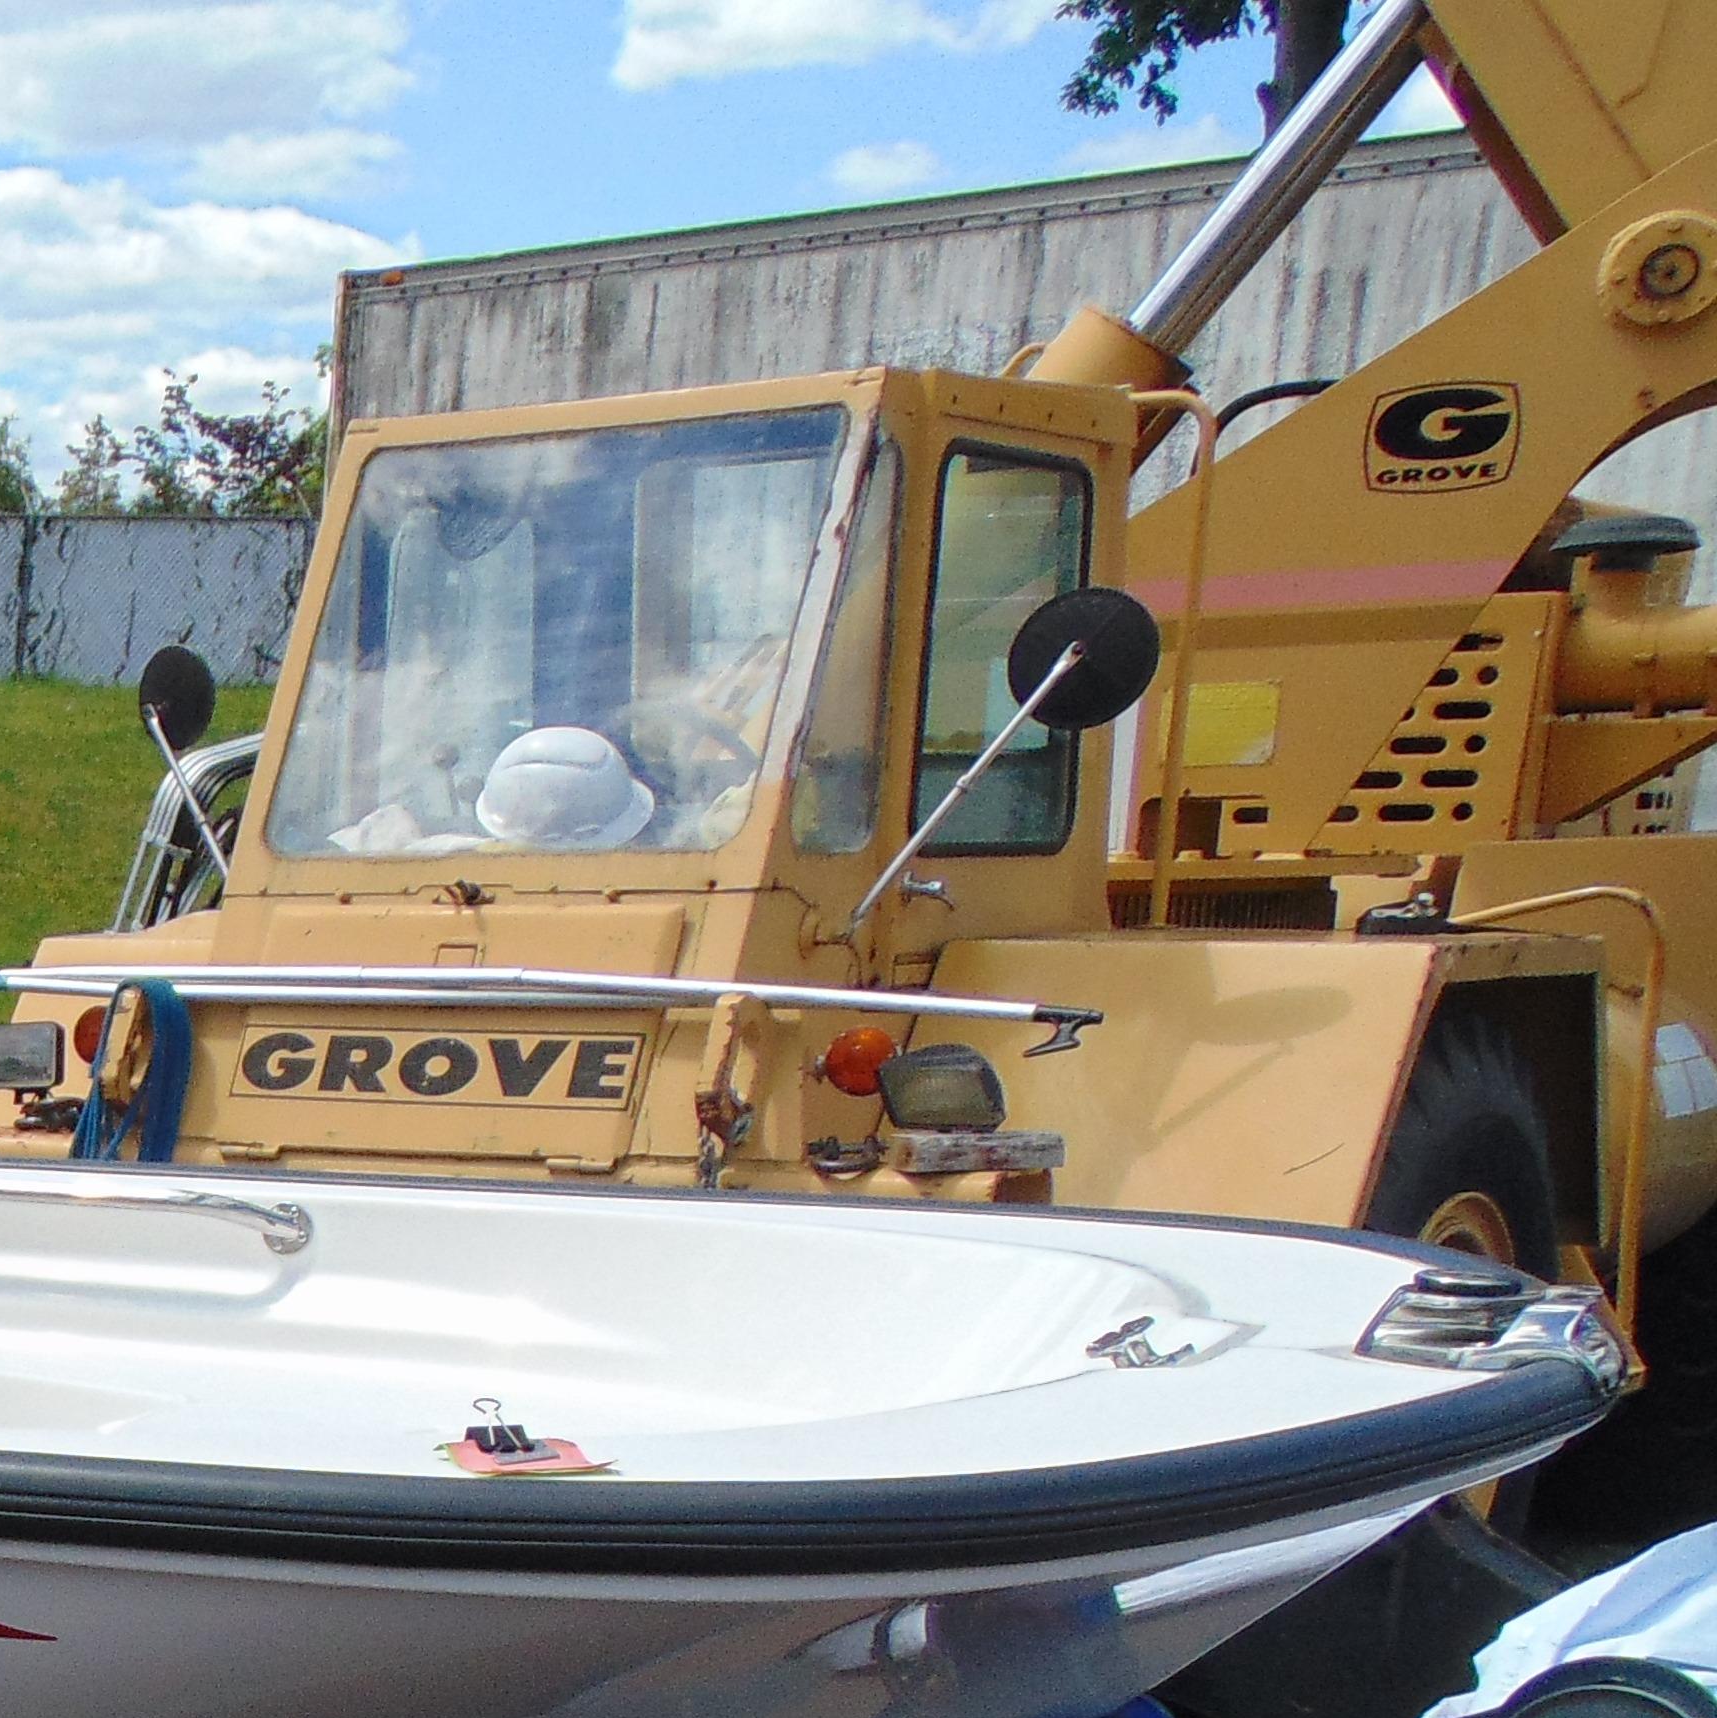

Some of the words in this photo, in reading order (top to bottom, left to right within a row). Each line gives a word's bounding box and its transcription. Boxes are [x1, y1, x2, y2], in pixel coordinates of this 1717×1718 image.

[1374, 388, 1511, 460] G
[1375, 462, 1498, 484] GROVE
[241, 1032, 636, 1099] GROVE
